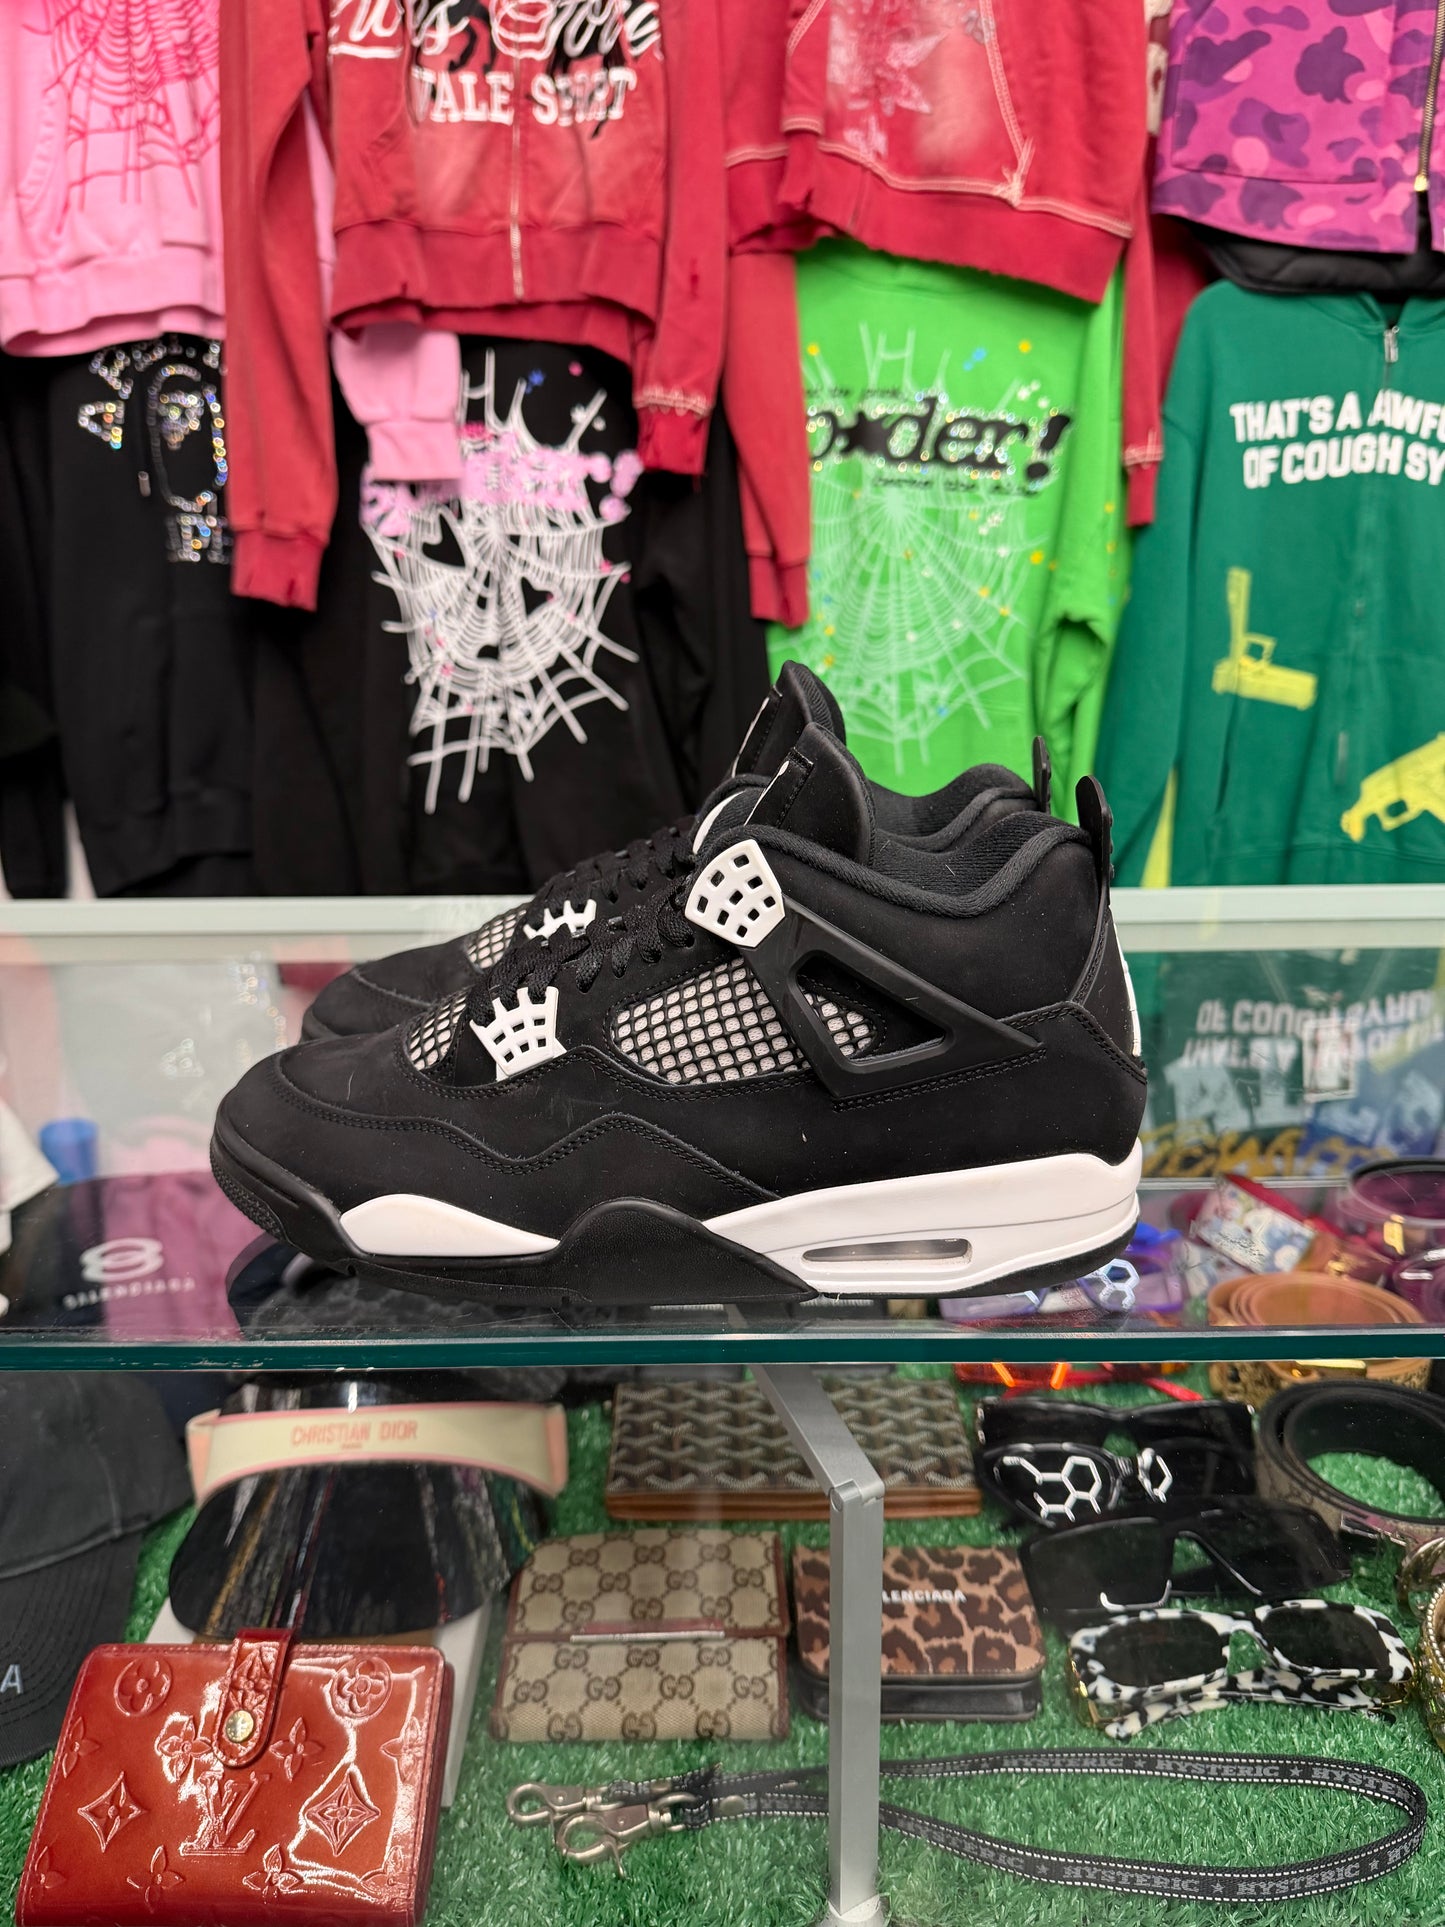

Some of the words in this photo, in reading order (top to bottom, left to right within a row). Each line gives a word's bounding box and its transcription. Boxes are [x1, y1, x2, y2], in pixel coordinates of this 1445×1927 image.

[1229, 395, 1334, 443] THAT'S
[1335, 391, 1362, 431] A
[1243, 445, 1280, 489] OF
[1281, 431, 1404, 485] COUGH
[291, 1421, 371, 1446] CHRISTIAN
[379, 1420, 418, 1441] DIOR
[1002, 1756, 1124, 1769] HYSTERIC
[1155, 1757, 1280, 1778] HYSTERIC
[1311, 1767, 1414, 1806] HYSTER
[1062, 1864, 1200, 1893] HYSTERIC
[1236, 1861, 1361, 1896] HYSTERIC
